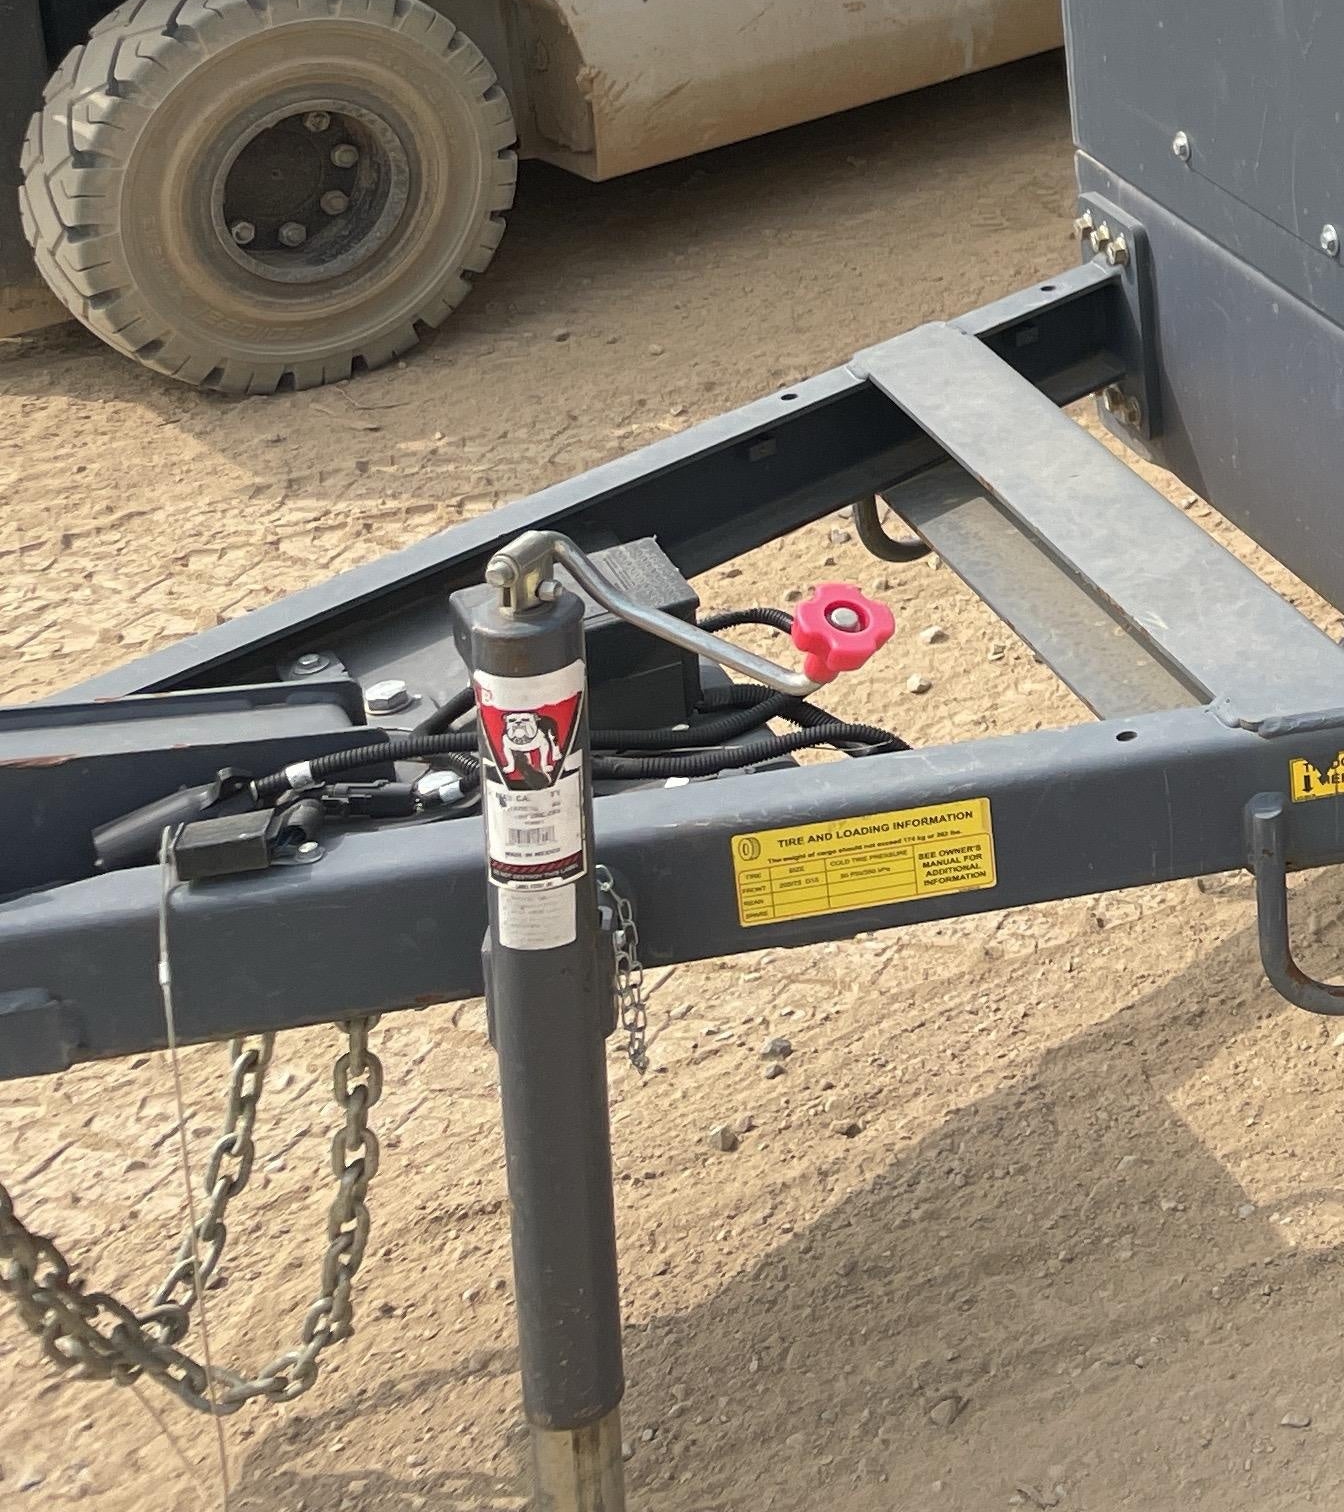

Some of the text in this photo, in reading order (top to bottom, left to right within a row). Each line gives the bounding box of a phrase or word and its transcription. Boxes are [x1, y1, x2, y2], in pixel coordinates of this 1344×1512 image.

[777, 811, 973, 849] TIRE AND LOADING INFORMATION
[918, 844, 982, 860] SEE OWNER'S
[829, 859, 850, 867] COLD
[851, 855, 868, 864] TIRE
[922, 853, 983, 868] MANUAL FOR
[925, 863, 981, 877] ADDITIONAL
[923, 870, 987, 886] INFORMATION
